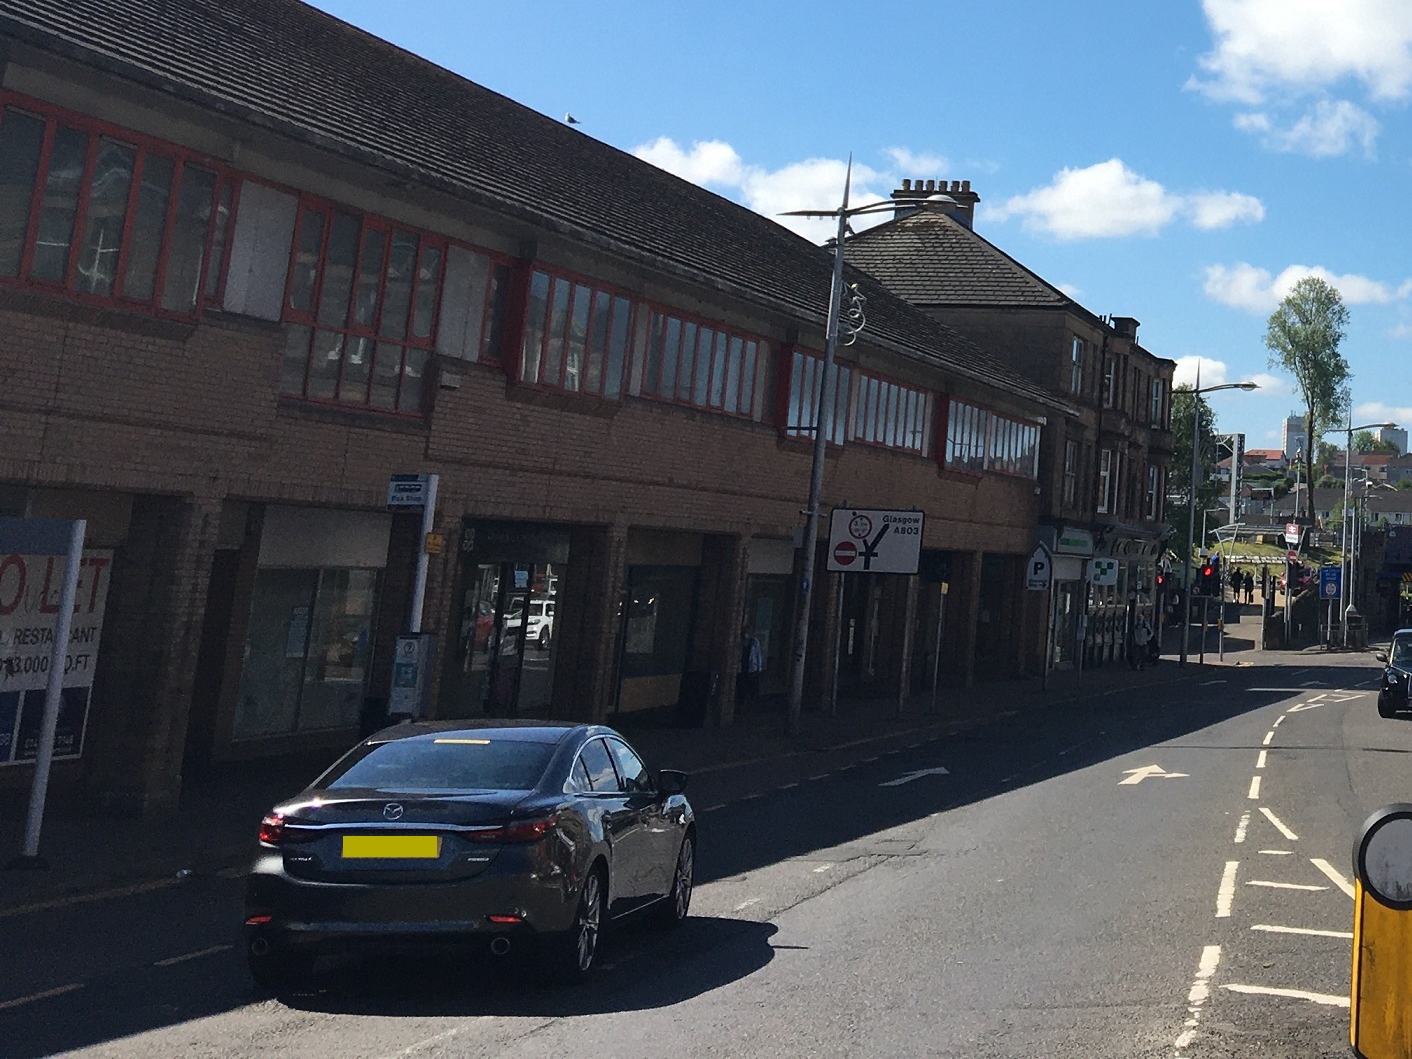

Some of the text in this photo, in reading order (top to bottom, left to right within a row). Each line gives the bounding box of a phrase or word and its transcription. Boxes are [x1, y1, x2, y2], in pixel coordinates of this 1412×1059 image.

[882, 515, 920, 525] Glasgow
[893, 527, 919, 535] A803
[1033, 561, 1045, 575] P
[40, 557, 110, 613] LT
[13, 627, 98, 645] RESTAANT
